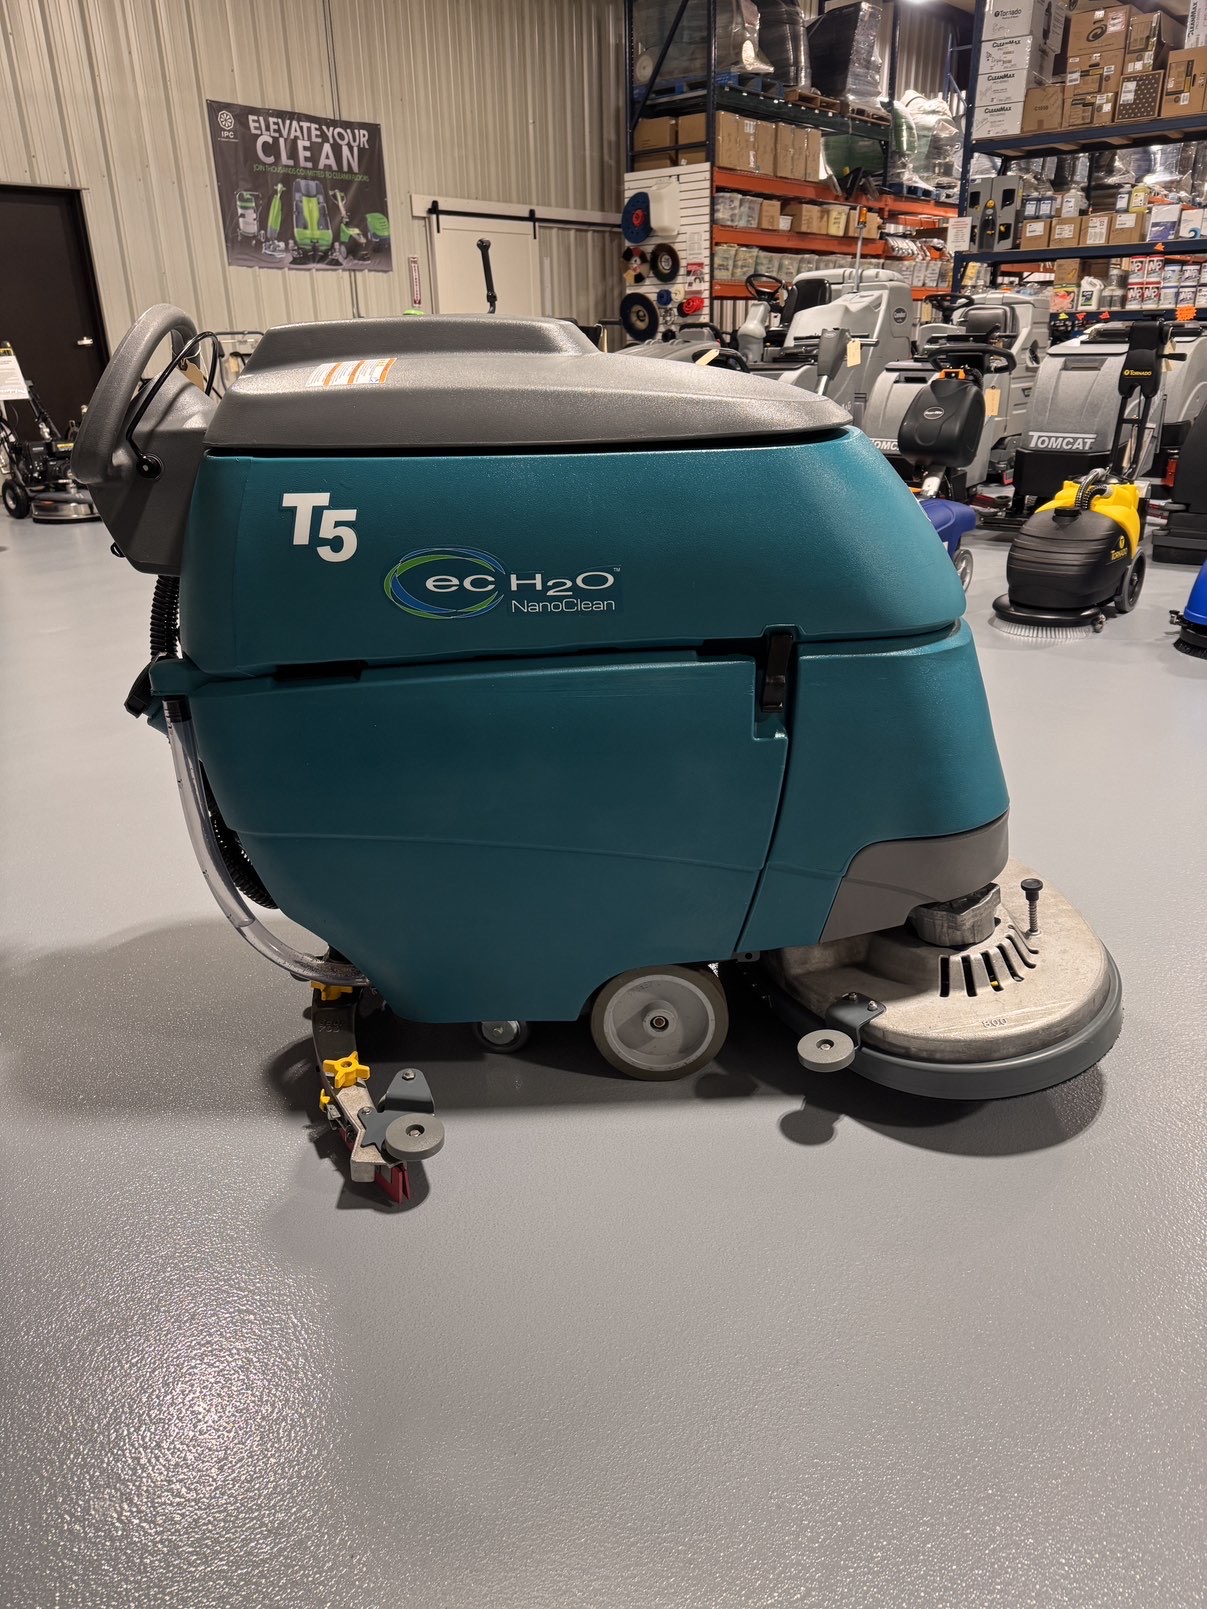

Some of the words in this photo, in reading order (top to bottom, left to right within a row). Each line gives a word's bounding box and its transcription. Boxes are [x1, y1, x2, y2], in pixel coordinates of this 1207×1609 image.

[221, 130, 235, 138] IPC
[248, 114, 322, 143] ELEVATE
[321, 125, 369, 149] YOUR
[256, 134, 359, 173] CLEAN
[1028, 431, 1097, 450] TOMCAT
[282, 492, 358, 563] T5
[511, 598, 616, 613] NanoClean
